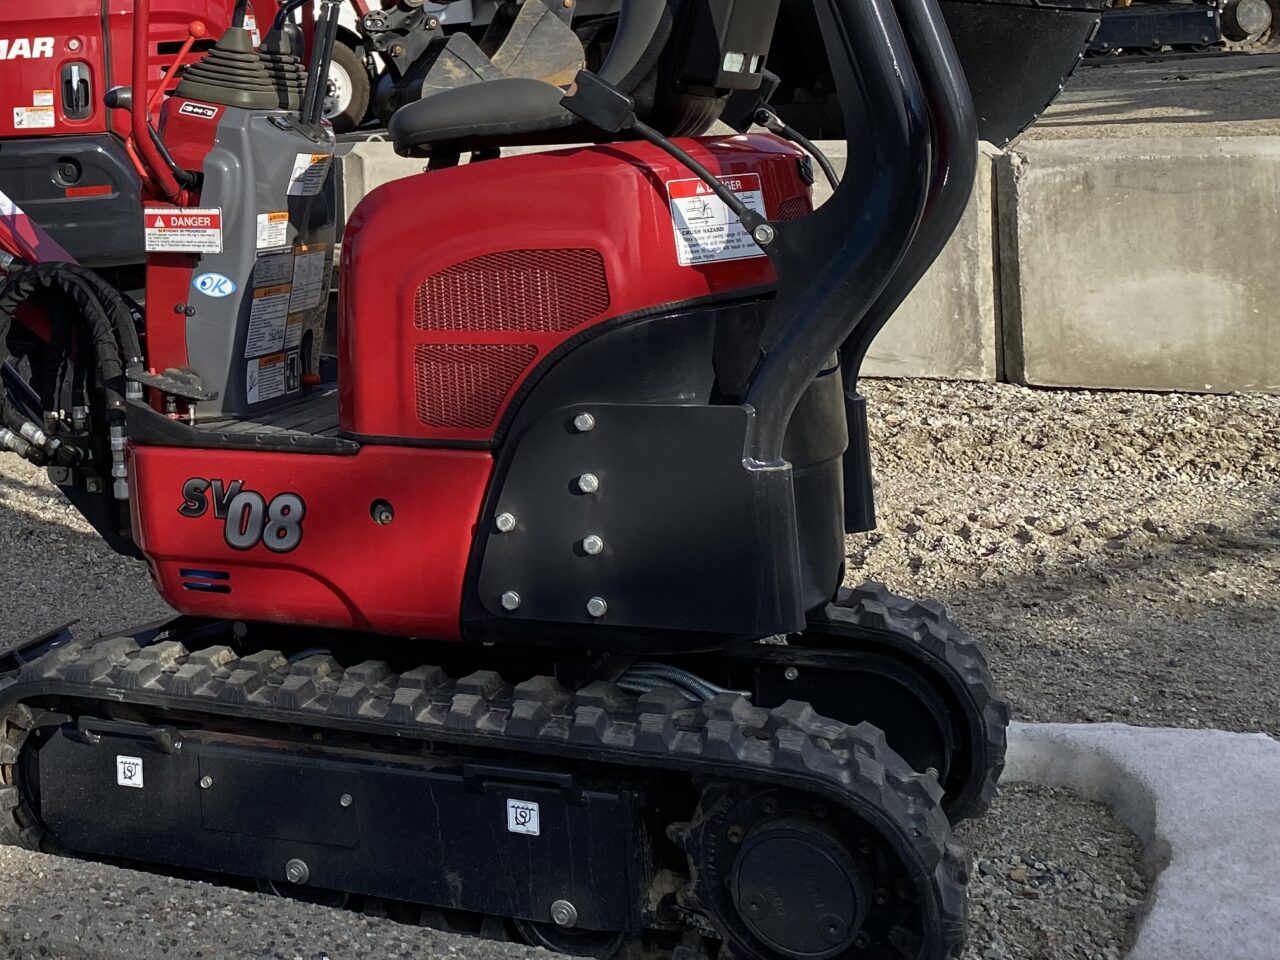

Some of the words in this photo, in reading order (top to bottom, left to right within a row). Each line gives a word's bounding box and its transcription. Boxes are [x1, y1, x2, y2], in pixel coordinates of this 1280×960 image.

[170, 216, 211, 227] DANGER
[200, 276, 227, 295] OK
[177, 476, 245, 520] SV
[224, 489, 307, 554] 08
